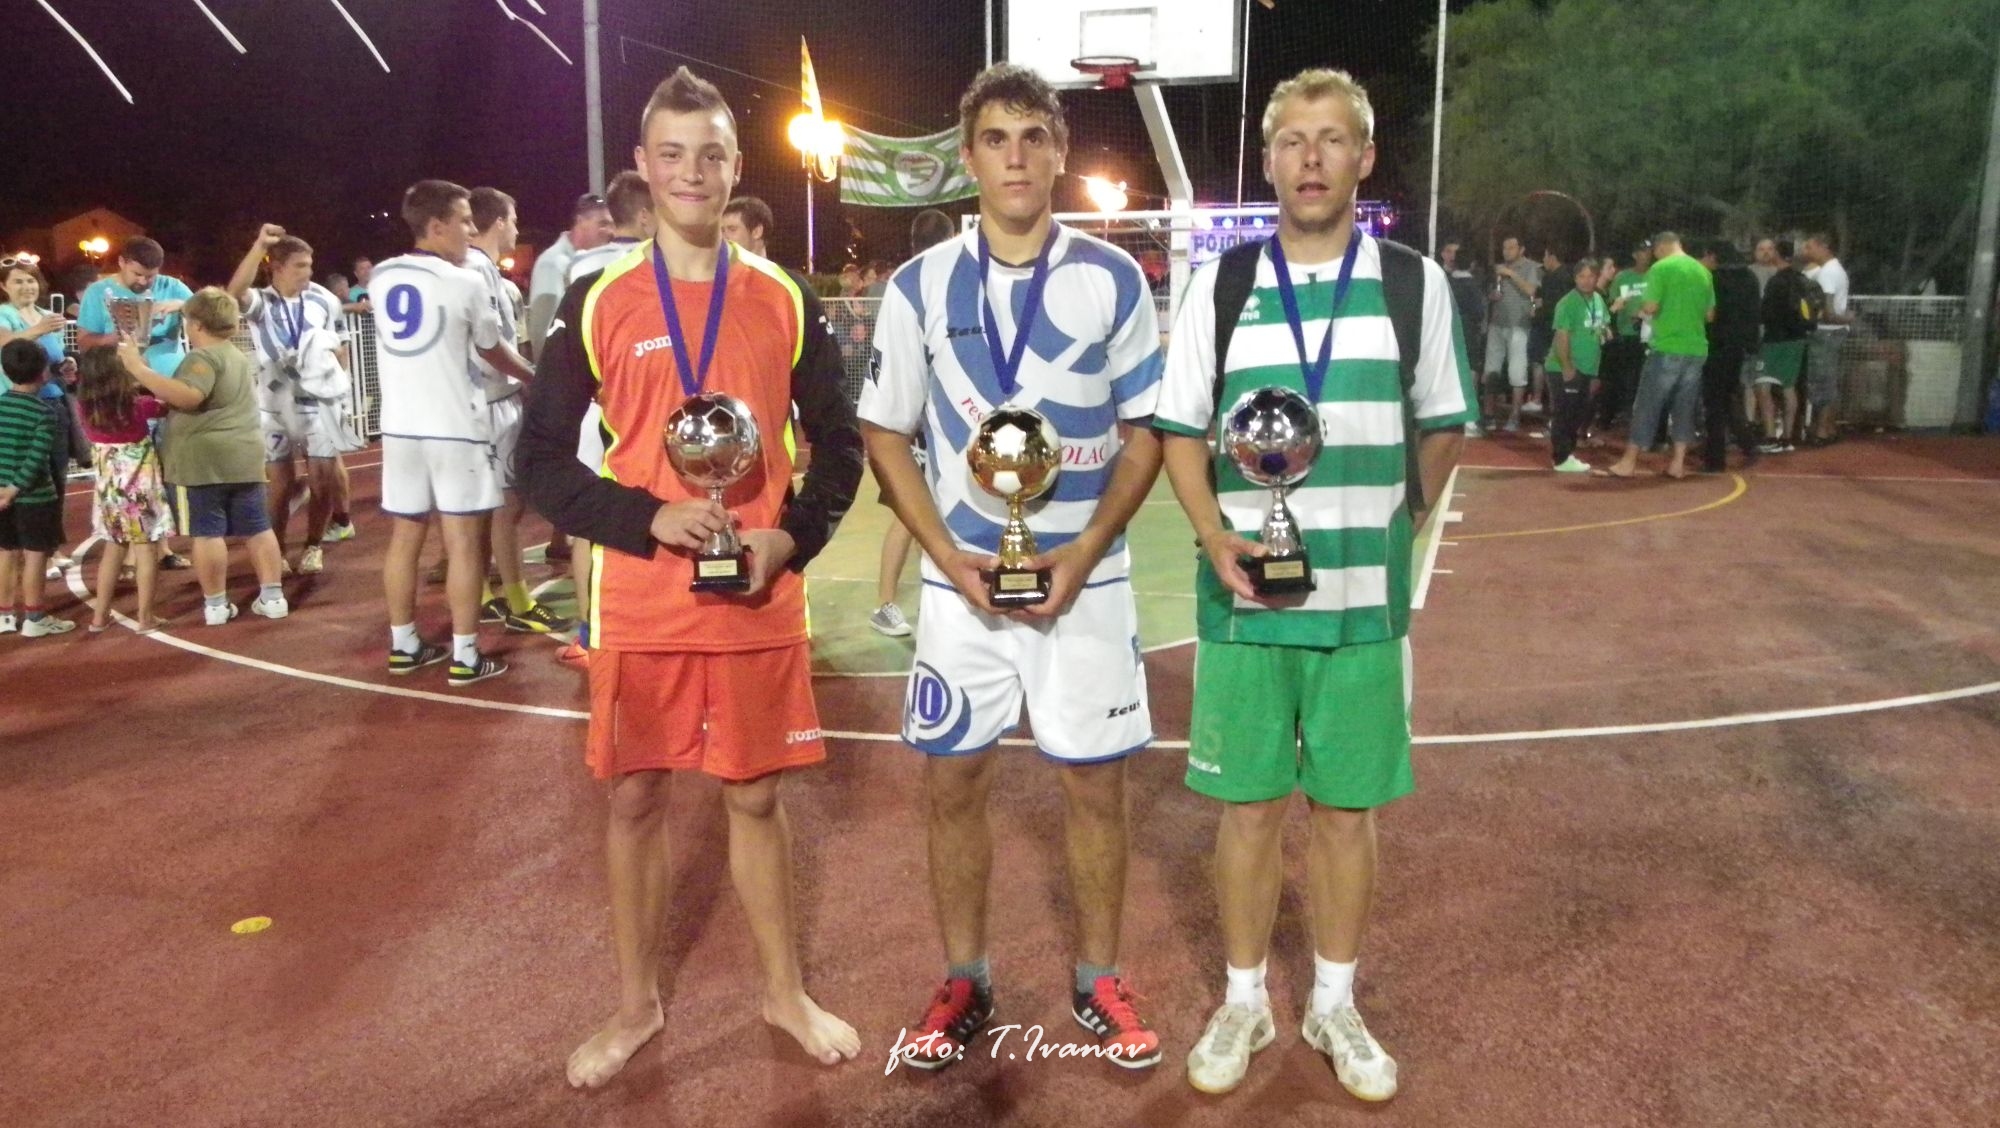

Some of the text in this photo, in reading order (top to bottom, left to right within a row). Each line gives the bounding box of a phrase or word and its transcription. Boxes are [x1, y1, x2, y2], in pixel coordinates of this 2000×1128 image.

[386, 284, 423, 340] 9
[946, 326, 986, 338] Zeu
[271, 433, 284, 450] 7
